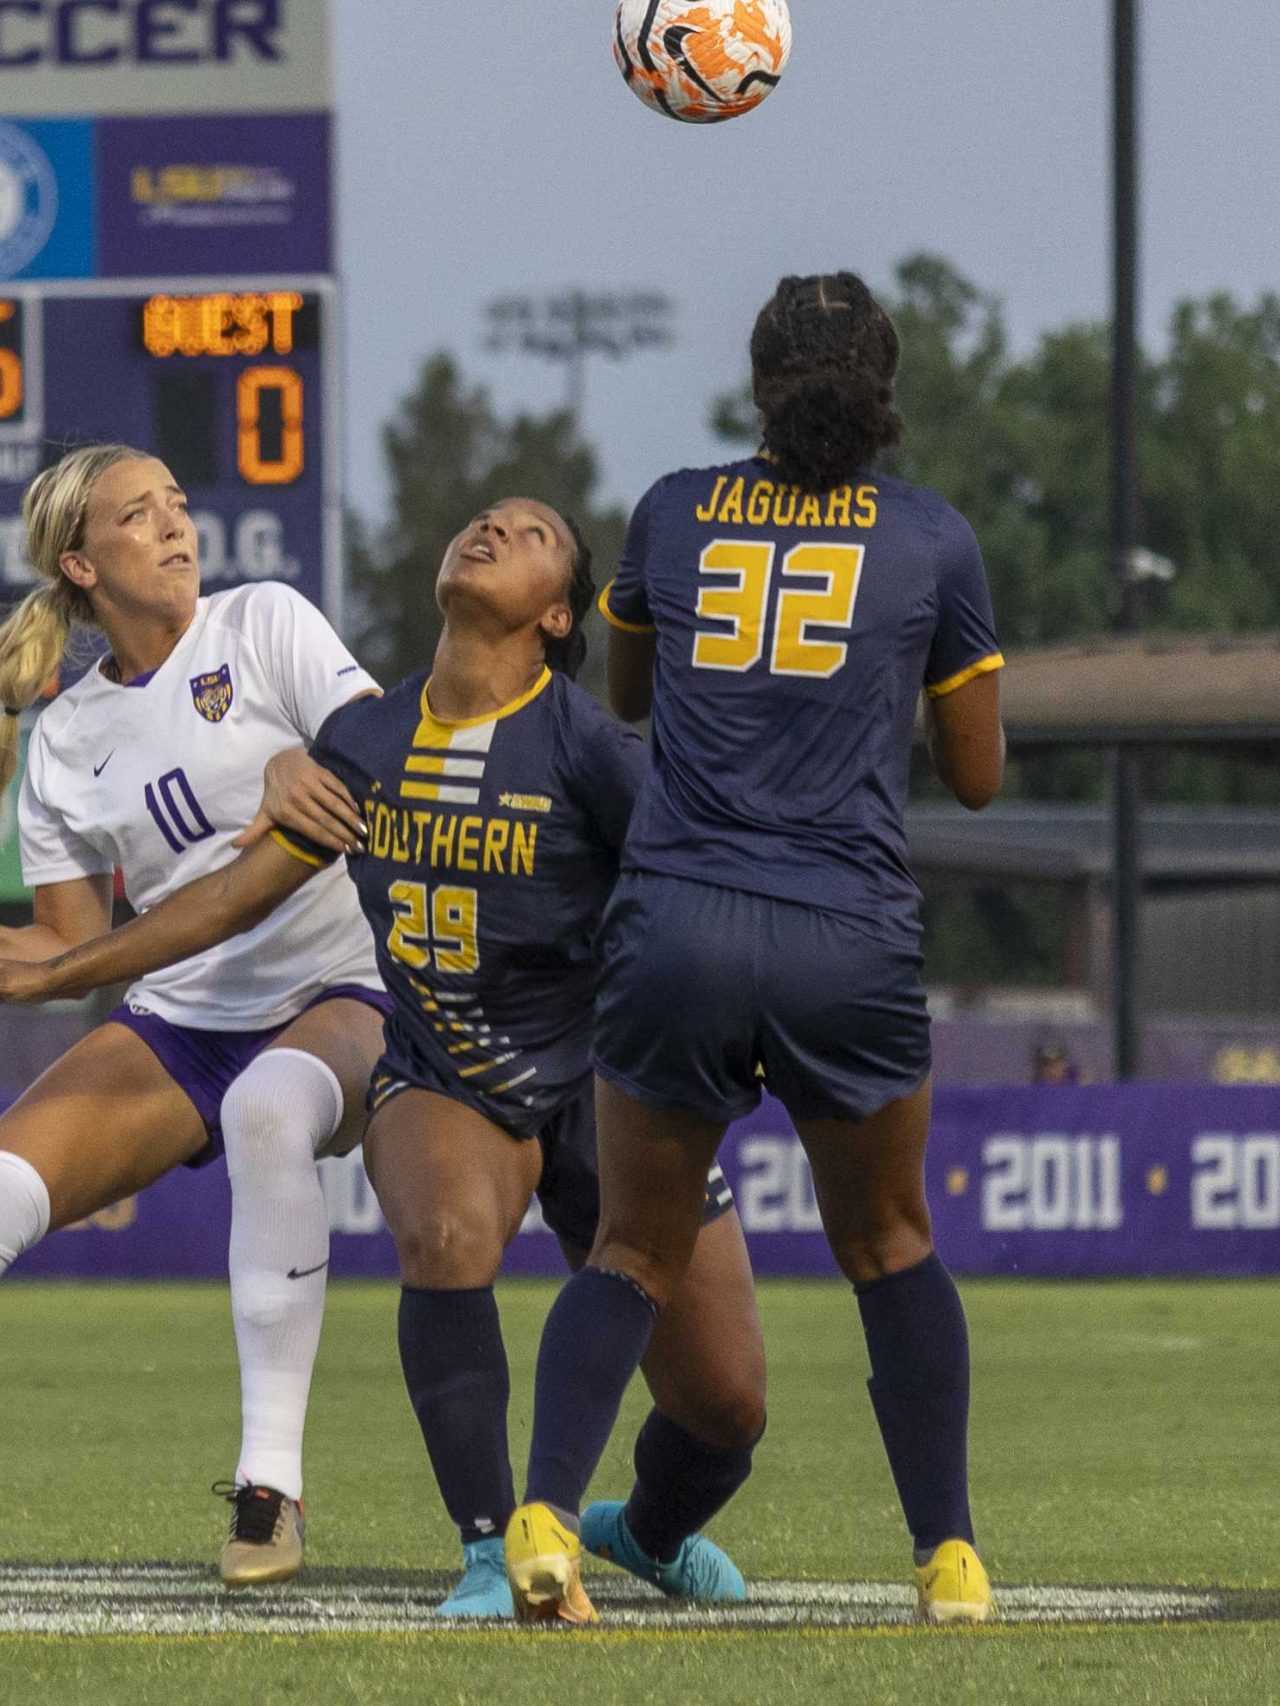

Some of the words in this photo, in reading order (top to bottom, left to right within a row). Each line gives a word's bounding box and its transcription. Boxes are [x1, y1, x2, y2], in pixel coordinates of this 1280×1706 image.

[144, 290, 304, 358] GUEST
[237, 365, 304, 484] 0
[695, 476, 878, 528] JAGUARS
[692, 538, 865, 679] 32
[144, 767, 217, 855] 10
[387, 879, 480, 975] 29
[981, 1136, 1120, 1230] 2011
